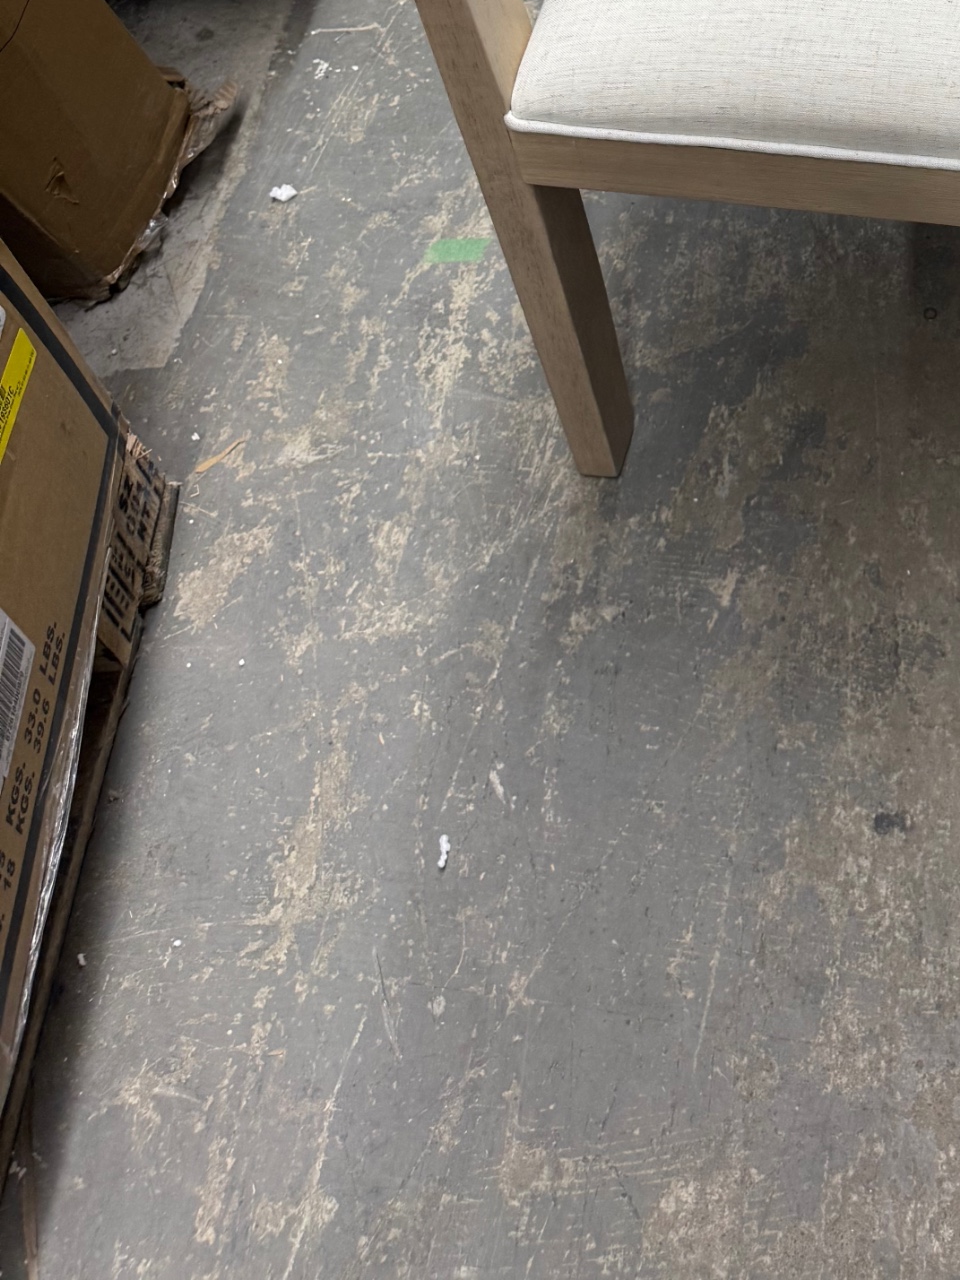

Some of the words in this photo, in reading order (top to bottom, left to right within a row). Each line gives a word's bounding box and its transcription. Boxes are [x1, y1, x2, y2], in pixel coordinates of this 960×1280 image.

[6, 762, 26, 827] KGS.
[24, 688, 41, 745] 33.0
[39, 622, 57, 676] LBS.
[15, 773, 35, 835] KGS.
[33, 698, 50, 754] 39.6
[48, 632, 66, 686] LBS.
